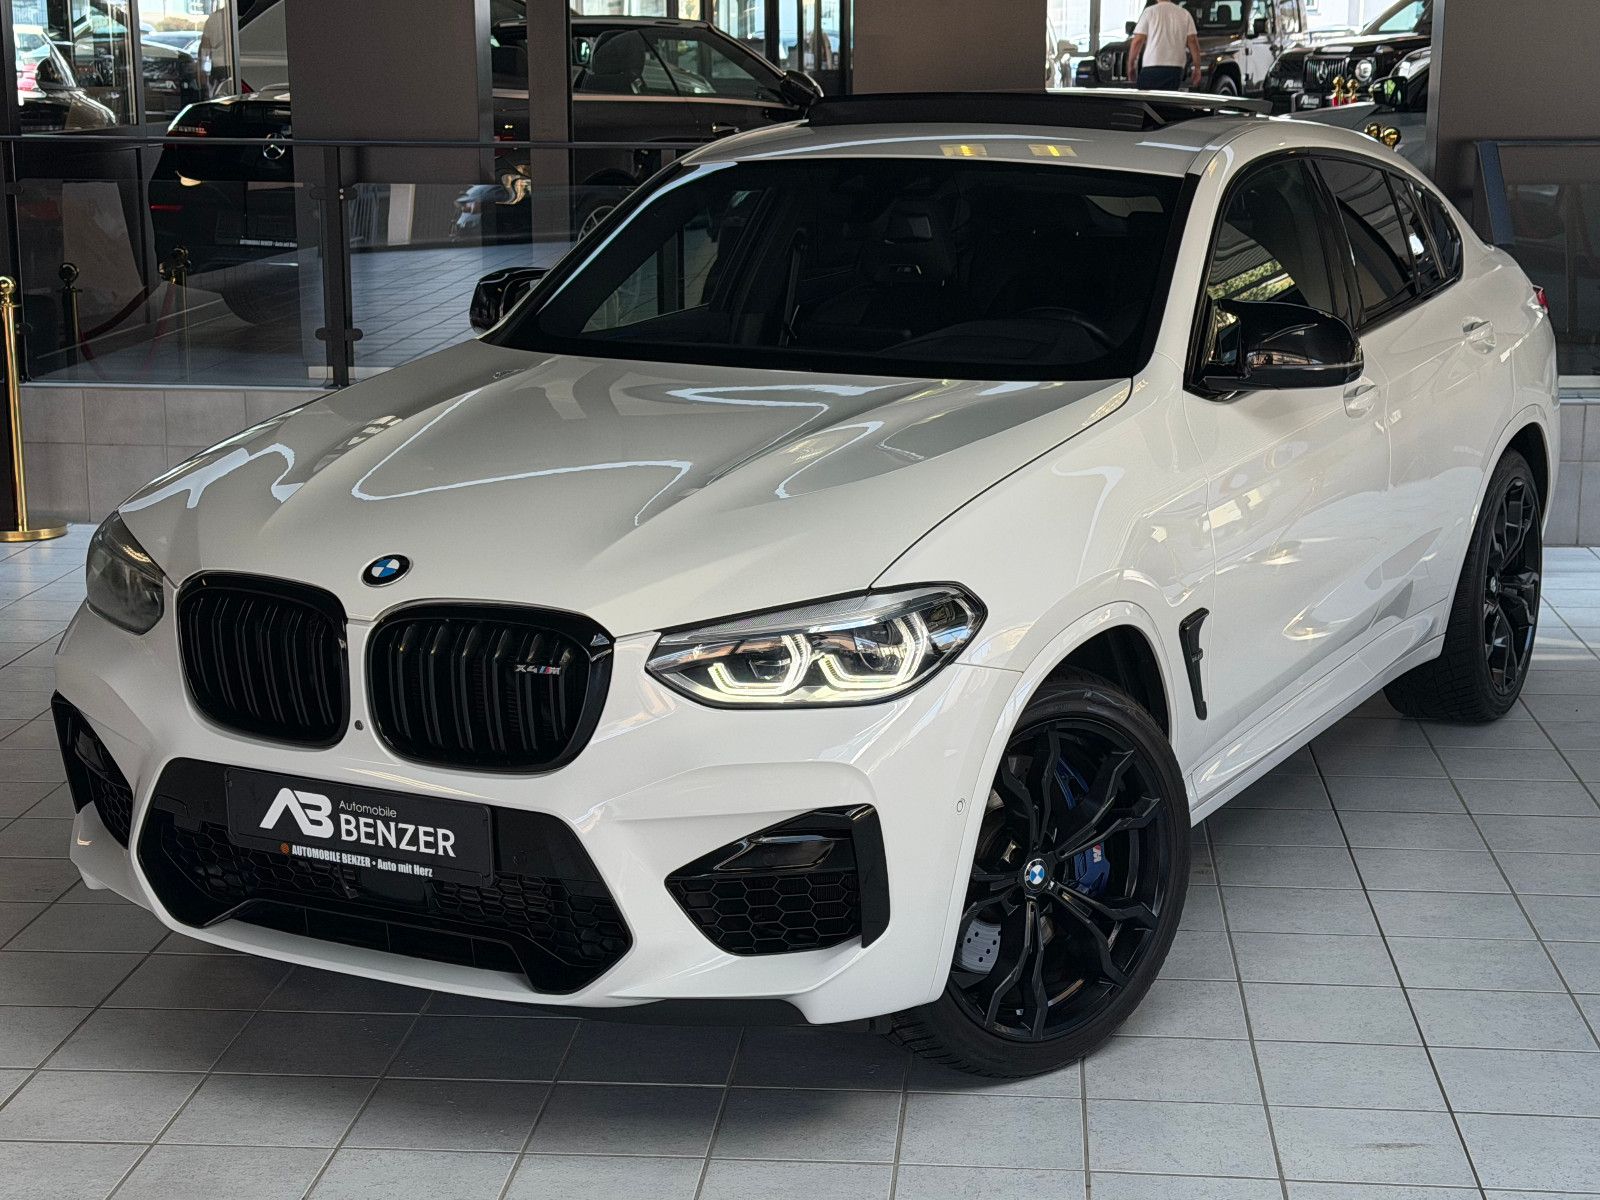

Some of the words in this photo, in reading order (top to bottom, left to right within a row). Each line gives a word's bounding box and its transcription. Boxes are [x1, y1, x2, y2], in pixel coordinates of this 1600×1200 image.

[259, 787, 335, 839] AB
[339, 800, 397, 818] Automobile
[339, 813, 457, 858] BENZER
[292, 844, 341, 863] AUTOMOBILE
[342, 852, 371, 868] BENZER
[377, 858, 397, 872] Auto
[398, 863, 413, 874] mit
[413, 864, 433, 877] Herz
